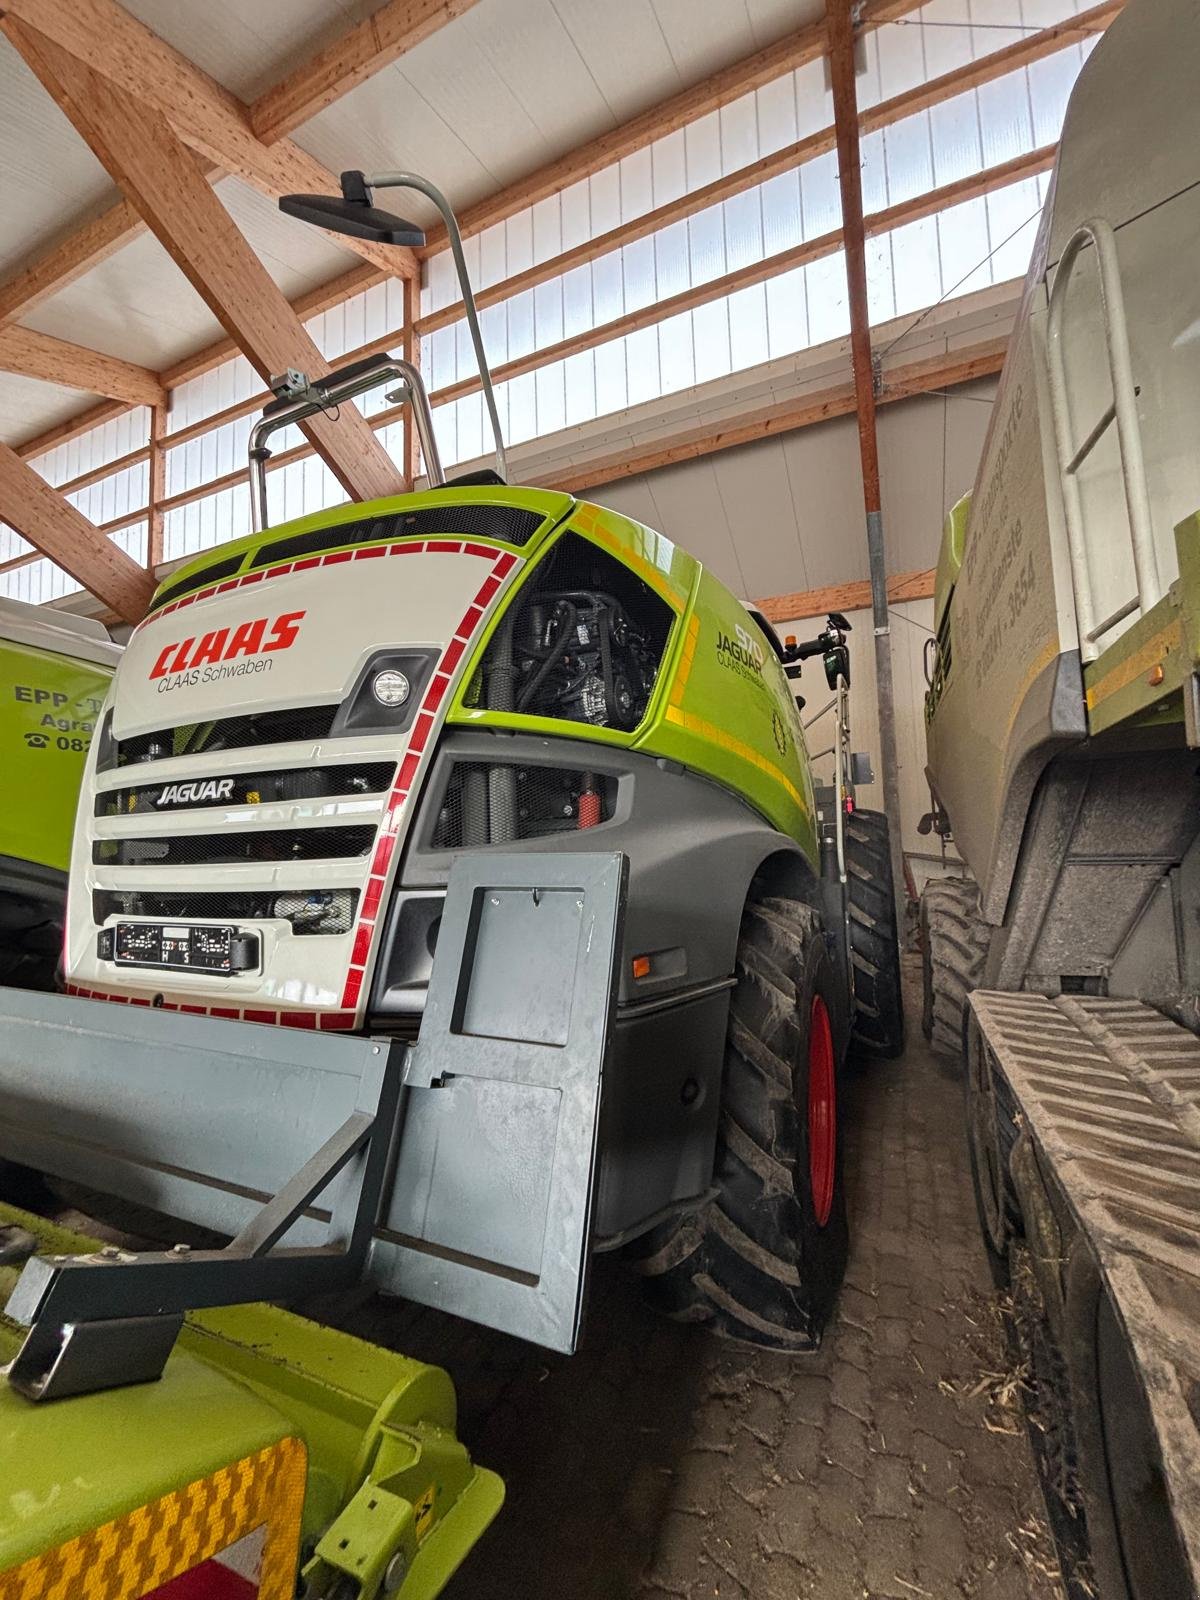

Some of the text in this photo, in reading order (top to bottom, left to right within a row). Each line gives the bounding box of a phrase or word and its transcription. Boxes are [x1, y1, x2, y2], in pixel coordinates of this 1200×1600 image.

[149, 610, 307, 680] CLAAS
[716, 631, 762, 675] JAGUAR
[157, 658, 273, 693] CLAAS Schwaben
[15, 686, 68, 707] EPP
[40, 713, 99, 733] Agra
[156, 778, 234, 805] JAGUAR
